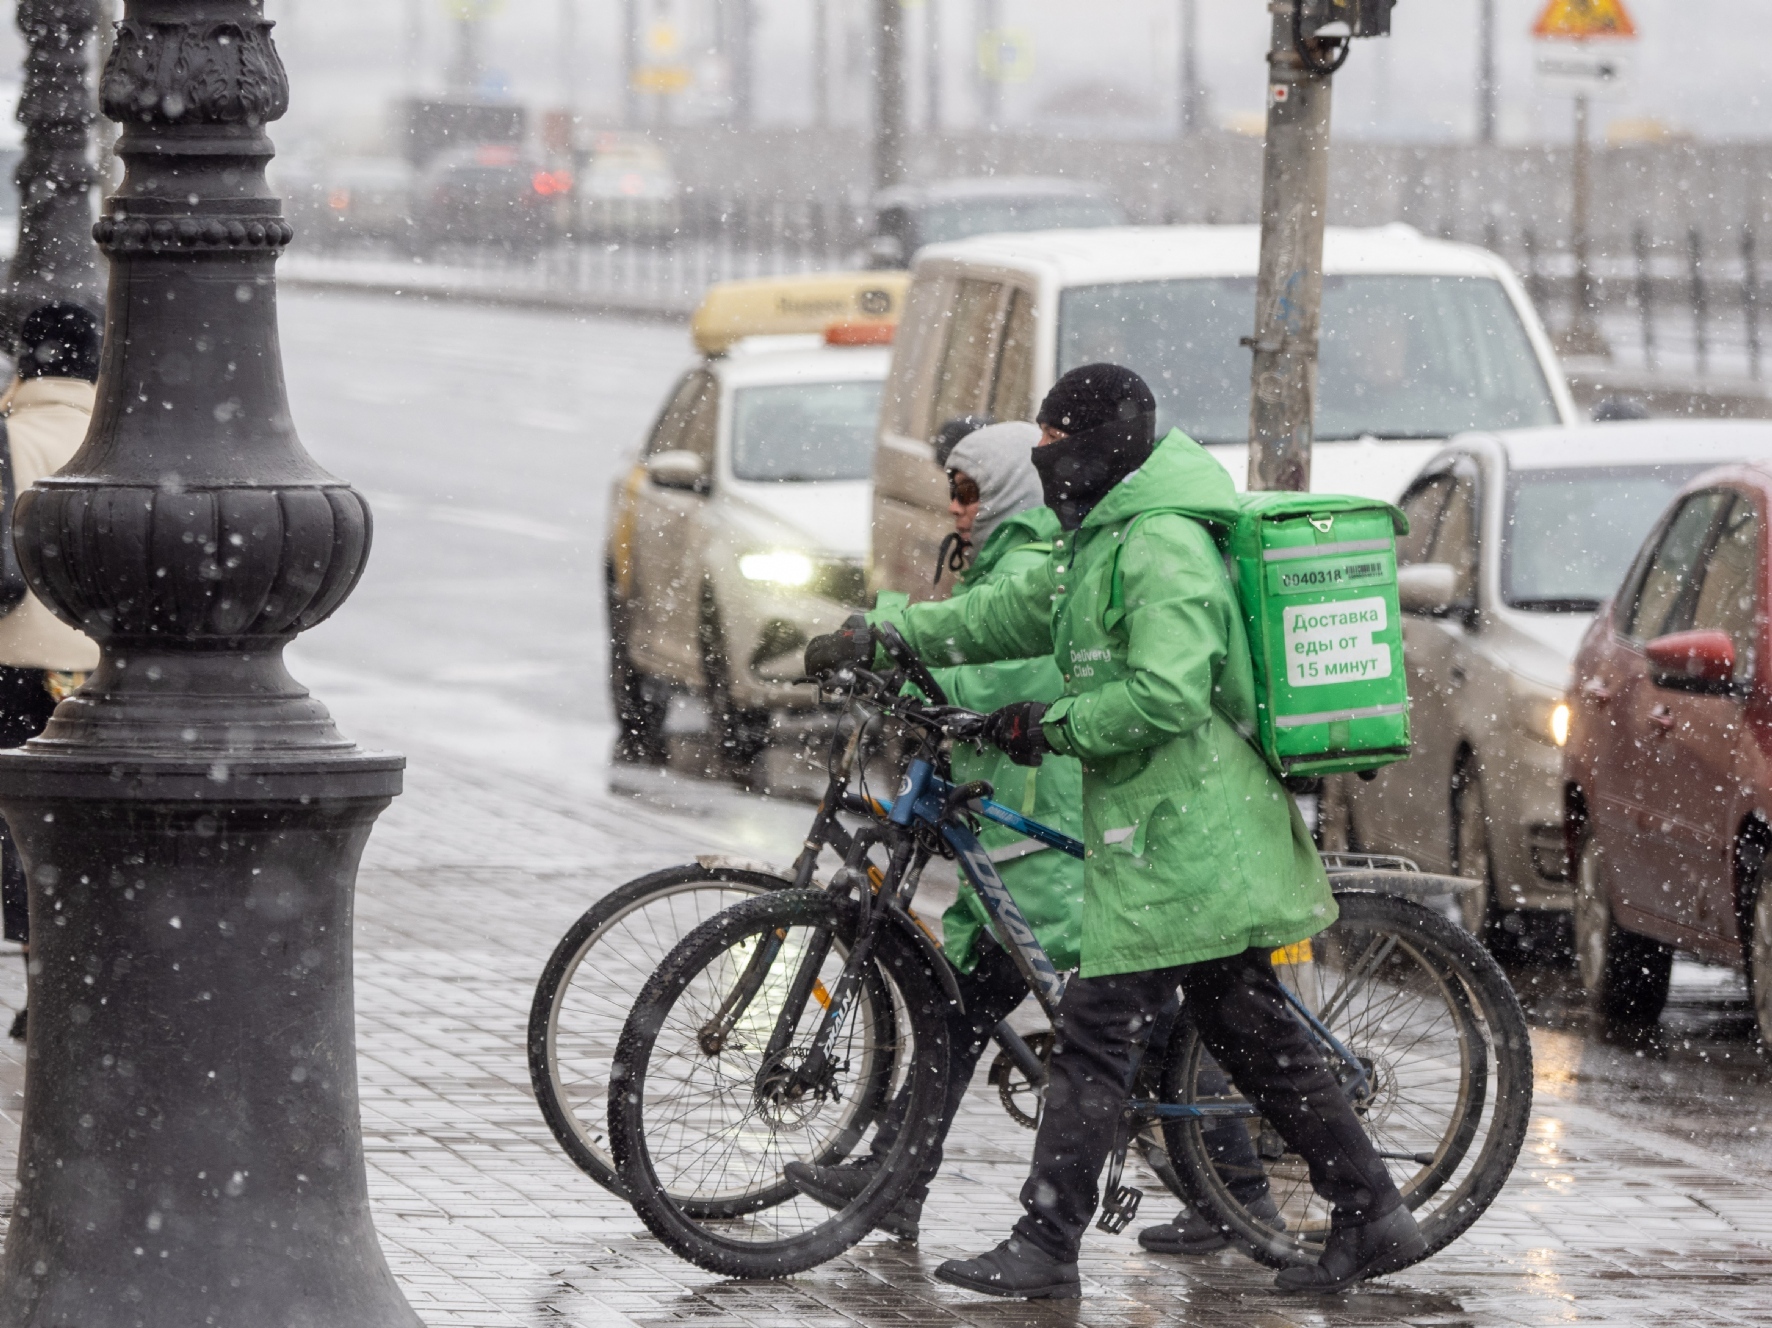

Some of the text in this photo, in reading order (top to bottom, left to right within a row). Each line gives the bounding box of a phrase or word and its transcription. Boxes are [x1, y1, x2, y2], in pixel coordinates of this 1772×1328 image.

[1283, 569, 1342, 587] 0040318
[1292, 609, 1379, 633] Доставка
[1070, 649, 1112, 662] Delivery
[1294, 636, 1358, 656] еды от
[1073, 665, 1095, 677] Club
[1296, 658, 1378, 678] 15 минут
